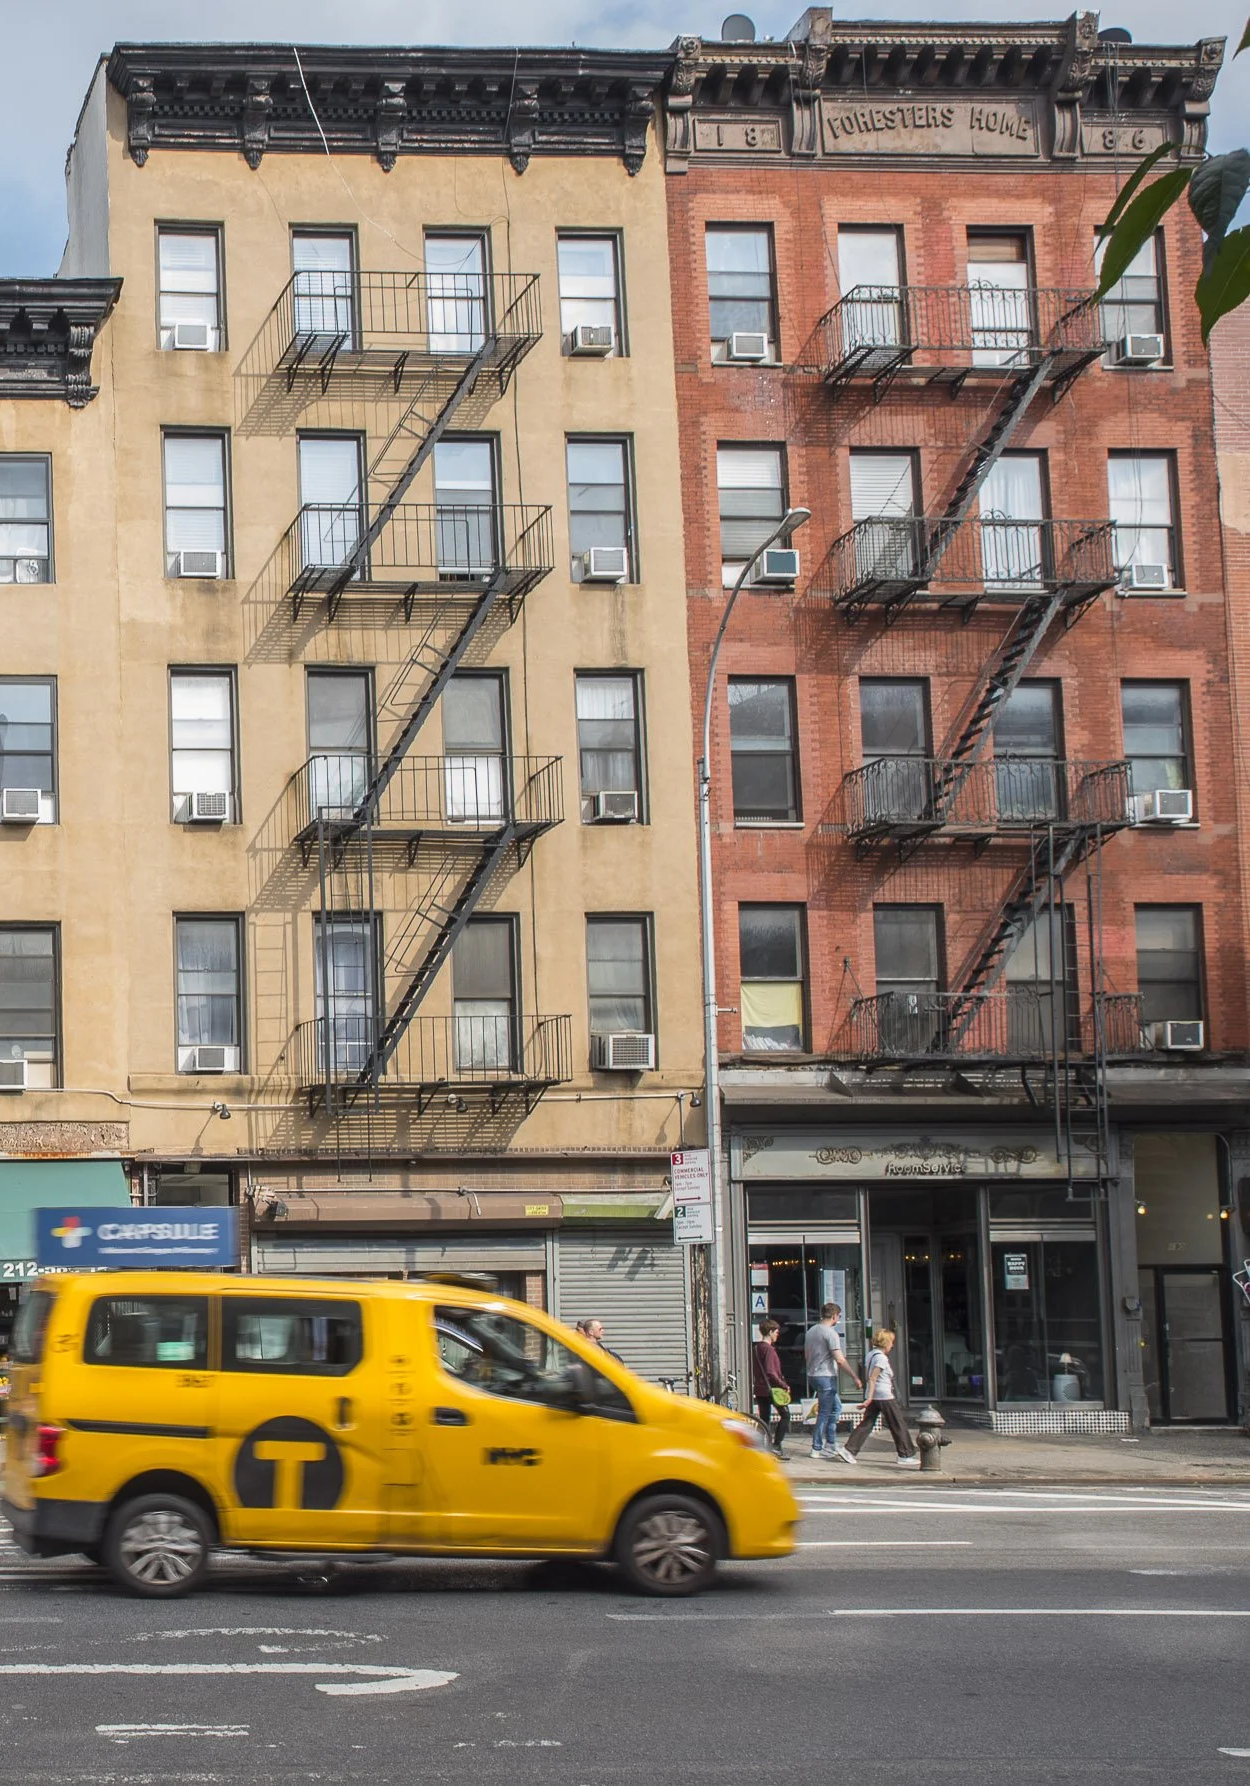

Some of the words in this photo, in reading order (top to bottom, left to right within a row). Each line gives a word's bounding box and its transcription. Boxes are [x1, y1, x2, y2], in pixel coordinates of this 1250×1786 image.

[828, 105, 956, 140] FORESTERS
[969, 106, 1032, 141] HOME
[675, 1154, 681, 1165] 3
[677, 1207, 684, 1217] 2
[98, 1223, 220, 1240] CAPSULE
[755, 1296, 765, 1308] A
[253, 1440, 327, 1508] T
